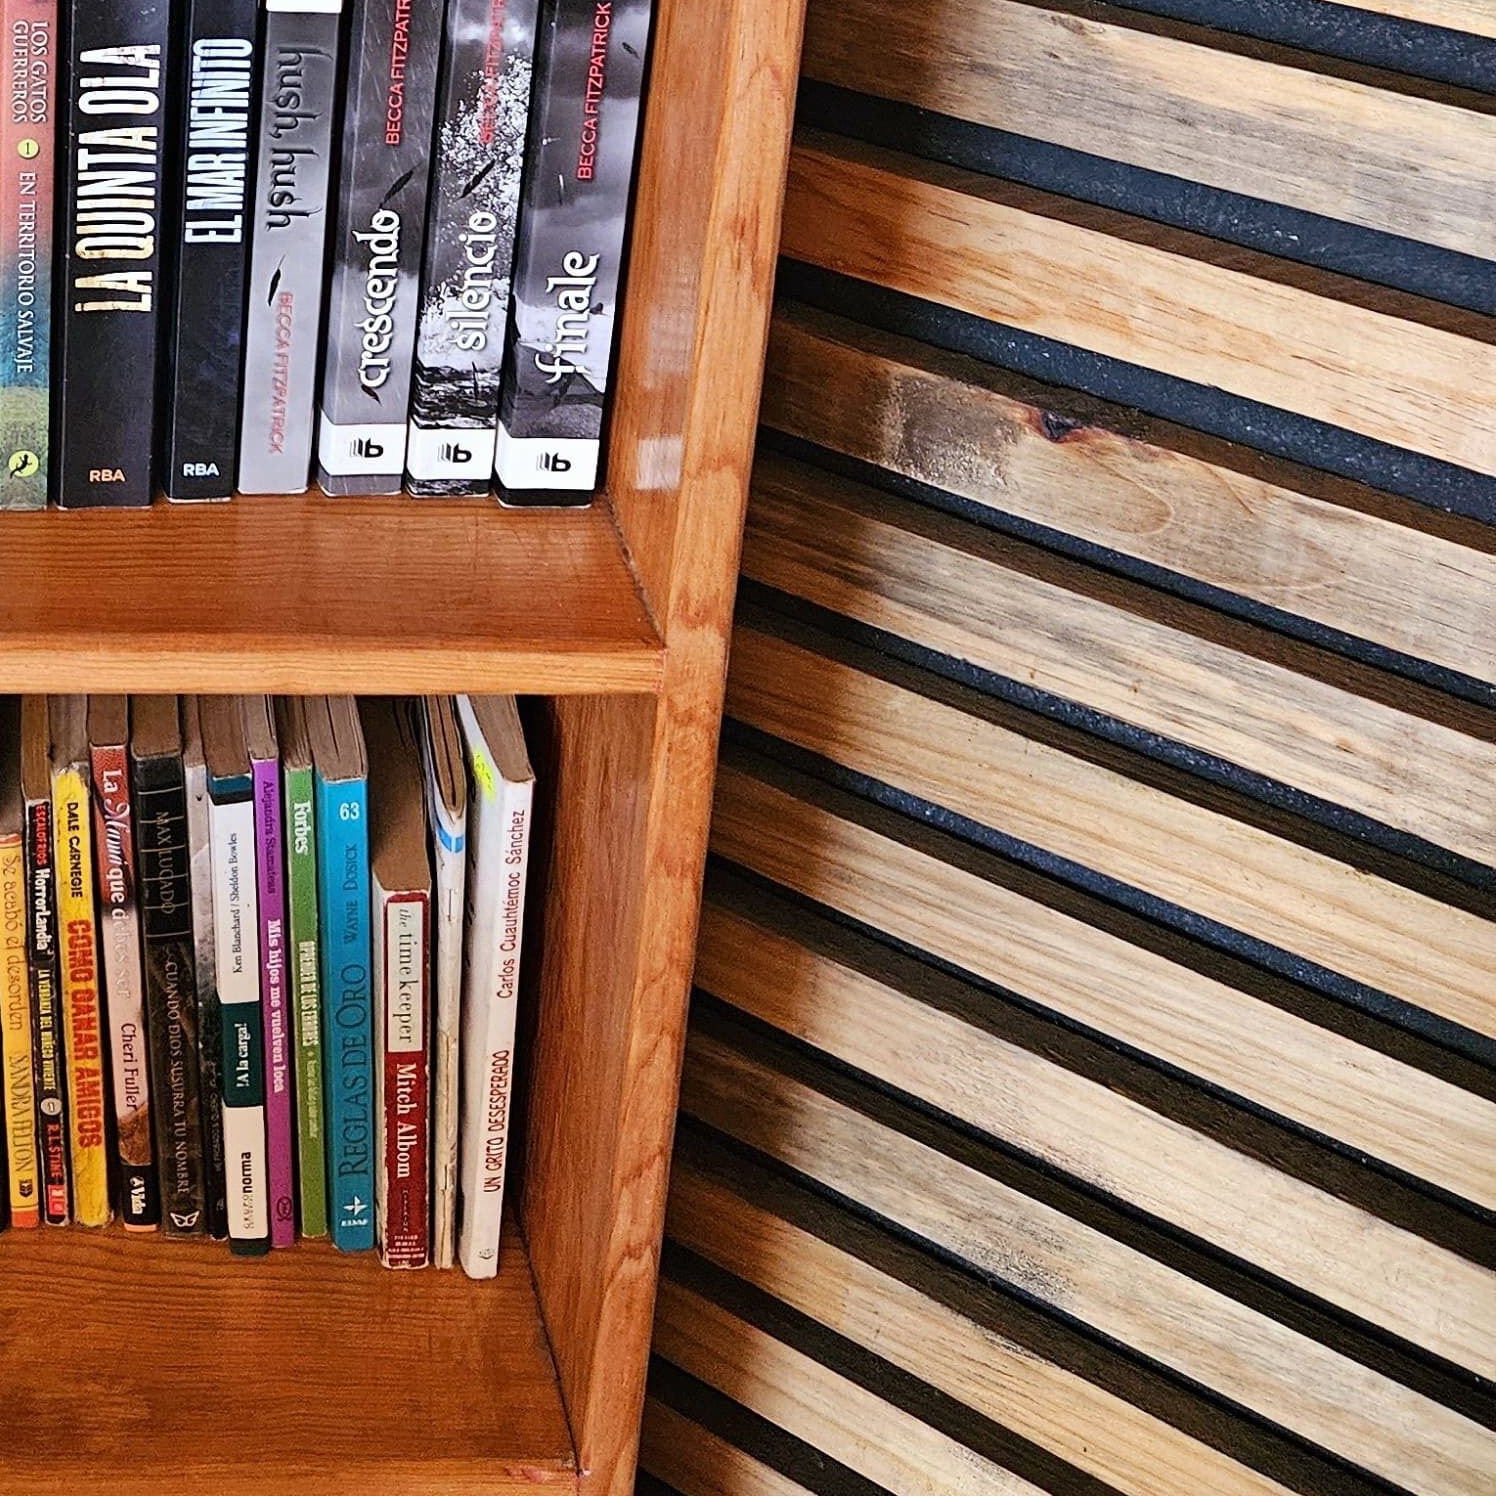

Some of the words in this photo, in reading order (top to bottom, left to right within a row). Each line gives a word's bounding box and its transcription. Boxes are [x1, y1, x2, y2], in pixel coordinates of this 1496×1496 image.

[31, 20, 47, 54] LOS
[584, 0, 612, 114] FITZPATRICK
[11, 19, 28, 122] GUERREROS
[28, 60, 47, 127] GATOS
[77, 38, 163, 116] OLA
[186, 32, 254, 149] INFINITO
[268, 46, 332, 140] hush,
[385, 82, 403, 144] BECCA
[577, 116, 597, 179] BECCA
[19, 171, 35, 193] EN
[75, 124, 157, 259] QUINTA
[186, 151, 245, 210] MAR
[266, 145, 323, 231] hush
[17, 200, 35, 305] TERRITORIO
[184, 214, 242, 243] EL
[74, 270, 152, 311] LA
[352, 207, 400, 387] crescendo
[444, 205, 500, 351] silencio
[15, 310, 33, 373] SALVAJE
[532, 247, 606, 388] finale
[90, 470, 125, 482] RBA
[184, 463, 219, 477] RBA
[101, 769, 119, 792] La
[65, 802, 79, 831] DALE
[292, 801, 312, 853] Forbes
[339, 803, 360, 820] 63
[504, 808, 525, 864] Sánchez
[1, 855, 21, 875] Se
[67, 835, 83, 897] CARNEGIE
[105, 868, 125, 902] que
[2, 880, 22, 930] acabó
[33, 868, 53, 950] HorrorLandia
[398, 909, 410, 927] the
[499, 870, 521, 952] Cuauhtémoc
[3, 935, 23, 950] el
[65, 919, 94, 982] COMO
[267, 920, 280, 945] Mis
[399, 933, 416, 974] time
[5, 956, 25, 1030] desorden
[164, 961, 180, 1019] CUANDO
[265, 949, 281, 983] hijos
[496, 957, 515, 999] Carlos
[270, 987, 280, 1007] me
[335, 964, 366, 1028] ORO
[393, 980, 417, 1043] keeper
[70, 988, 98, 1060] GANAR
[120, 1022, 138, 1063] Cheri
[168, 1024, 182, 1056] DIOS
[271, 1010, 285, 1063] vuelven
[342, 1035, 367, 1067] DE
[123, 1067, 141, 1111] Fuller
[170, 1059, 185, 1117] SUSURRA
[273, 1065, 285, 1092] loca
[396, 1064, 416, 1114] Mitch
[486, 1048, 509, 1132] DESESPERADO
[75, 1066, 102, 1148] AMIGOS
[173, 1120, 186, 1137] TU
[338, 1075, 369, 1177] REGLAS
[174, 1141, 189, 1192] NOMBRE
[396, 1121, 415, 1178] Albom
[484, 1136, 504, 1171] GRITO
[483, 1175, 501, 1192] UN
